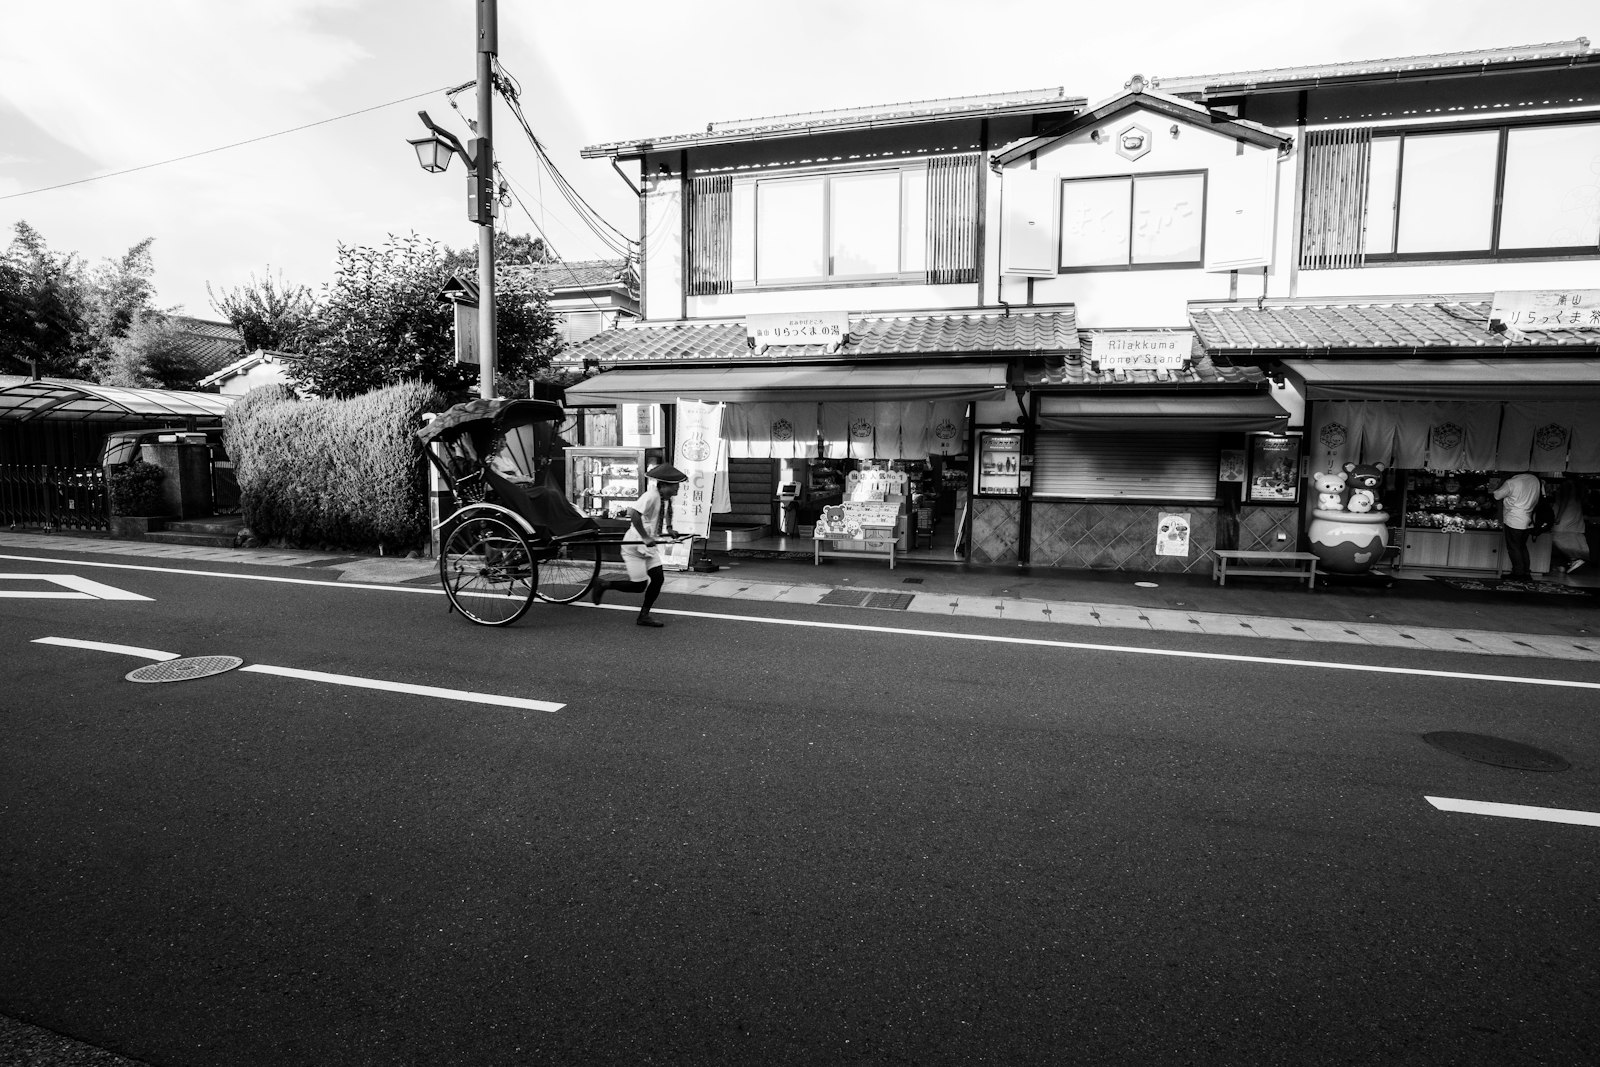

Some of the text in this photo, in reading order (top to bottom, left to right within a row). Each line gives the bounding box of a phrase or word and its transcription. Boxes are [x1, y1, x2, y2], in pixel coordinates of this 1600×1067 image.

[1108, 340, 1175, 350] Rilakkuma
[1100, 353, 1182, 364] Honey Stand
